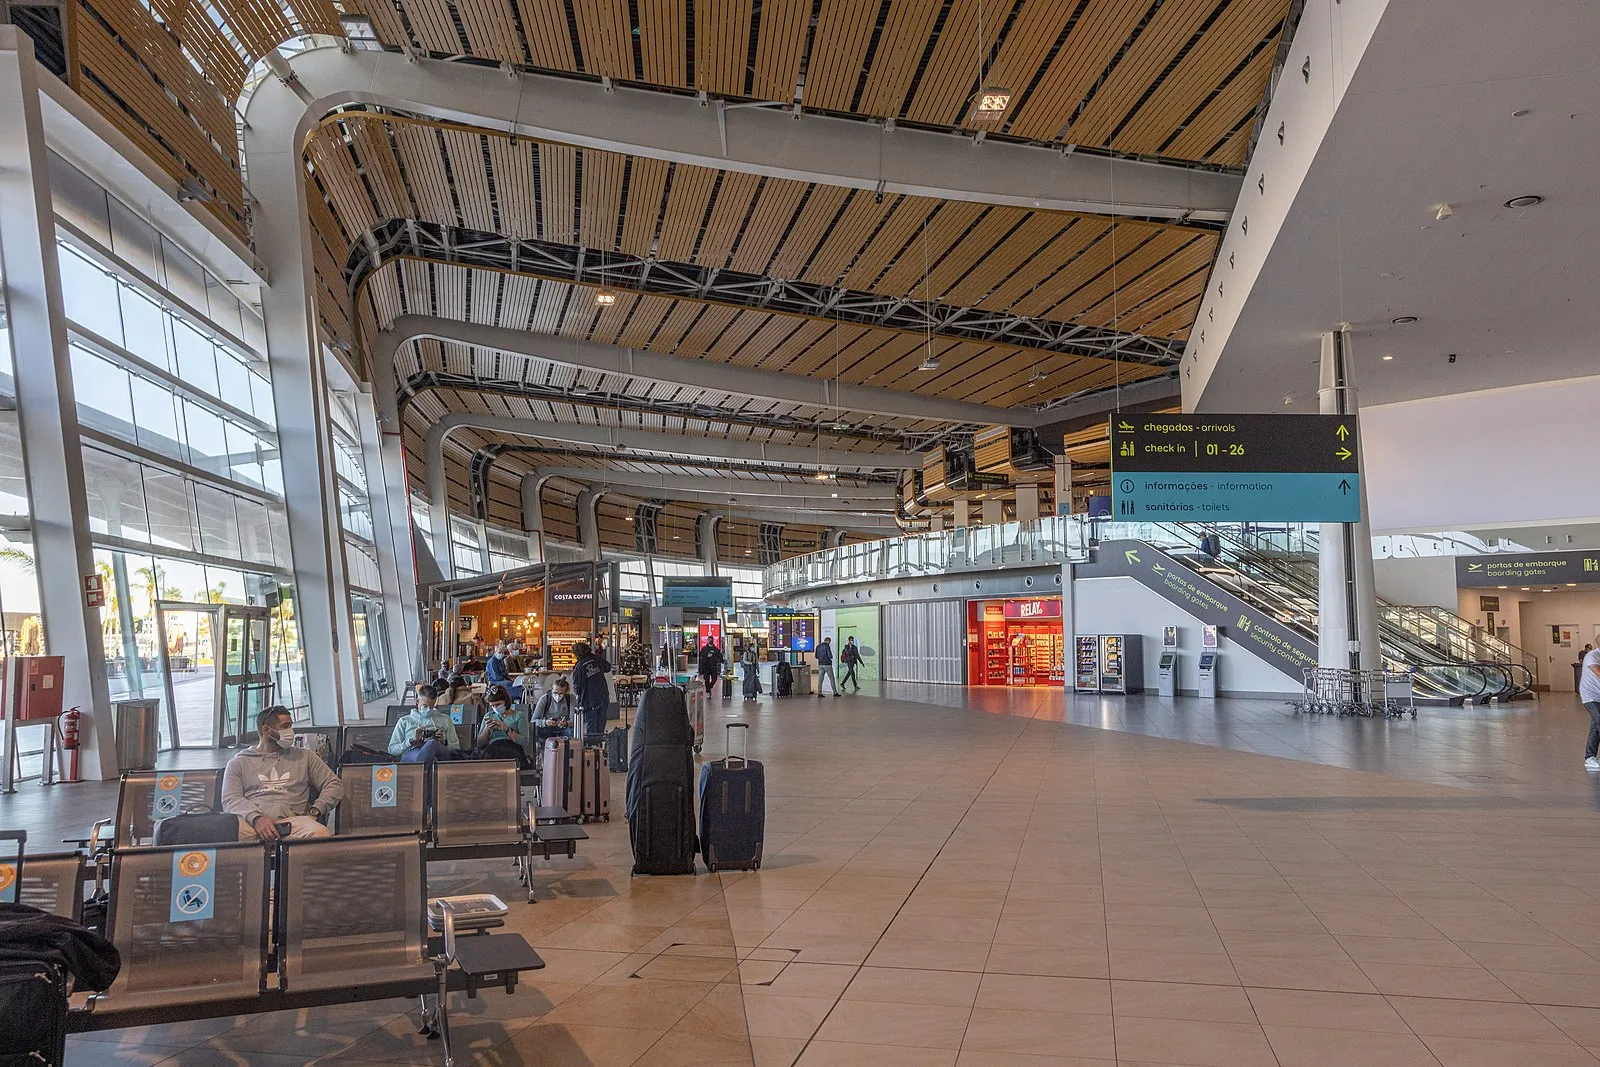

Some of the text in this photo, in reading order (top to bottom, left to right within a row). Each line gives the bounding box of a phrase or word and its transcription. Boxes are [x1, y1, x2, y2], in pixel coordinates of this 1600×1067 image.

[1143, 422, 1194, 434] chegadas
[1201, 423, 1236, 433] arrivals
[1144, 443, 1175, 453] check
[1176, 443, 1186, 453] in
[1206, 443, 1219, 456] 01
[1229, 444, 1245, 456] 26
[1144, 481, 1208, 492] informações
[1217, 481, 1273, 491] information
[1145, 502, 1194, 512] sanitários
[1202, 502, 1230, 512] toilets
[1487, 562, 1513, 570] portas
[1487, 569, 1522, 577] boarding
[1164, 578, 1209, 610] boarding gates
[1166, 572, 1229, 612] portas de embarque
[1020, 601, 1041, 617] RELAY
[1254, 624, 1282, 645] controlo
[1282, 642, 1292, 650] de
[1250, 632, 1303, 667] security control
